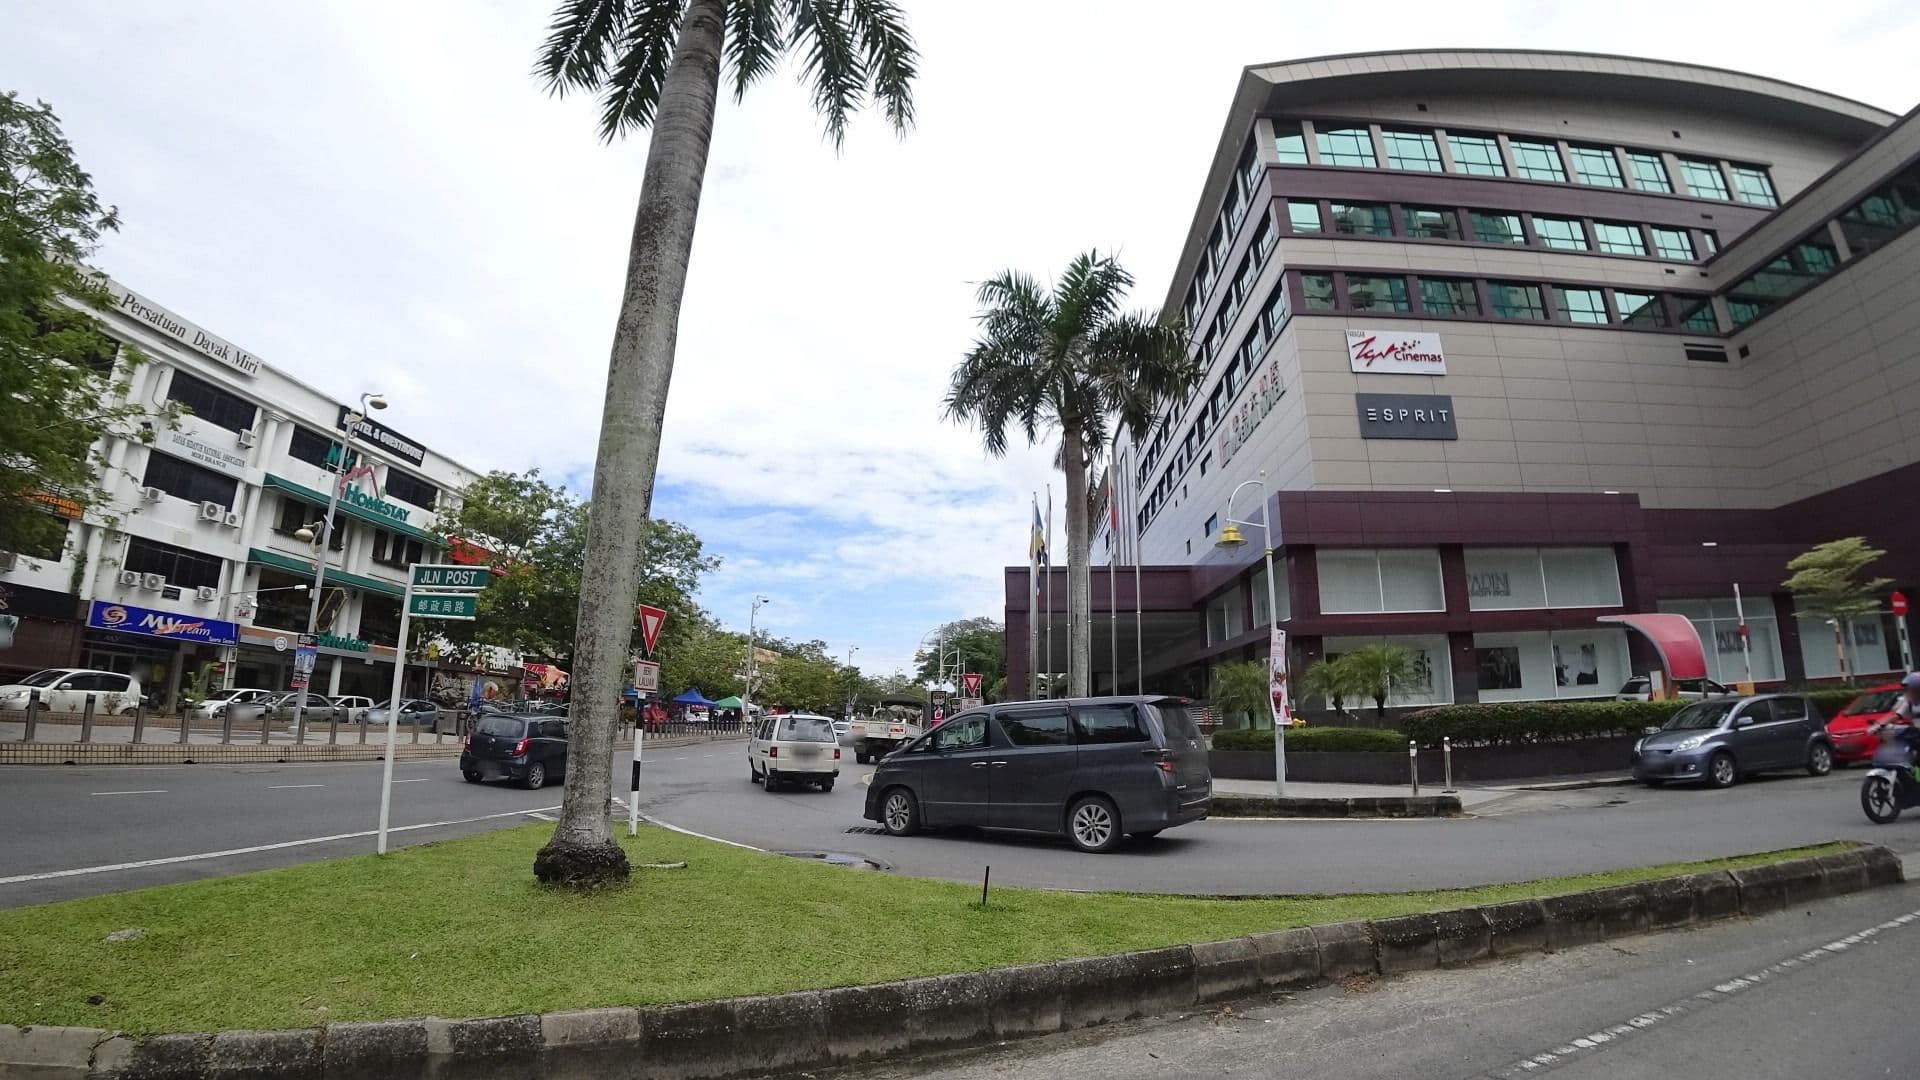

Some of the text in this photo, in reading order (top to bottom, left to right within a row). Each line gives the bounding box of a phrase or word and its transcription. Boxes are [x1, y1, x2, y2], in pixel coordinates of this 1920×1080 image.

[121, 293, 187, 338] Persatuan
[193, 331, 231, 360] Dayak
[232, 351, 260, 374] Miri
[1394, 350, 1443, 362] Cinemas
[1367, 408, 1449, 422] ESPRIT
[373, 428, 381, 440] &
[380, 431, 424, 461] GUESTHOUSE
[420, 570, 477, 585] JLN POST
[418, 599, 465, 613] 邮政局路
